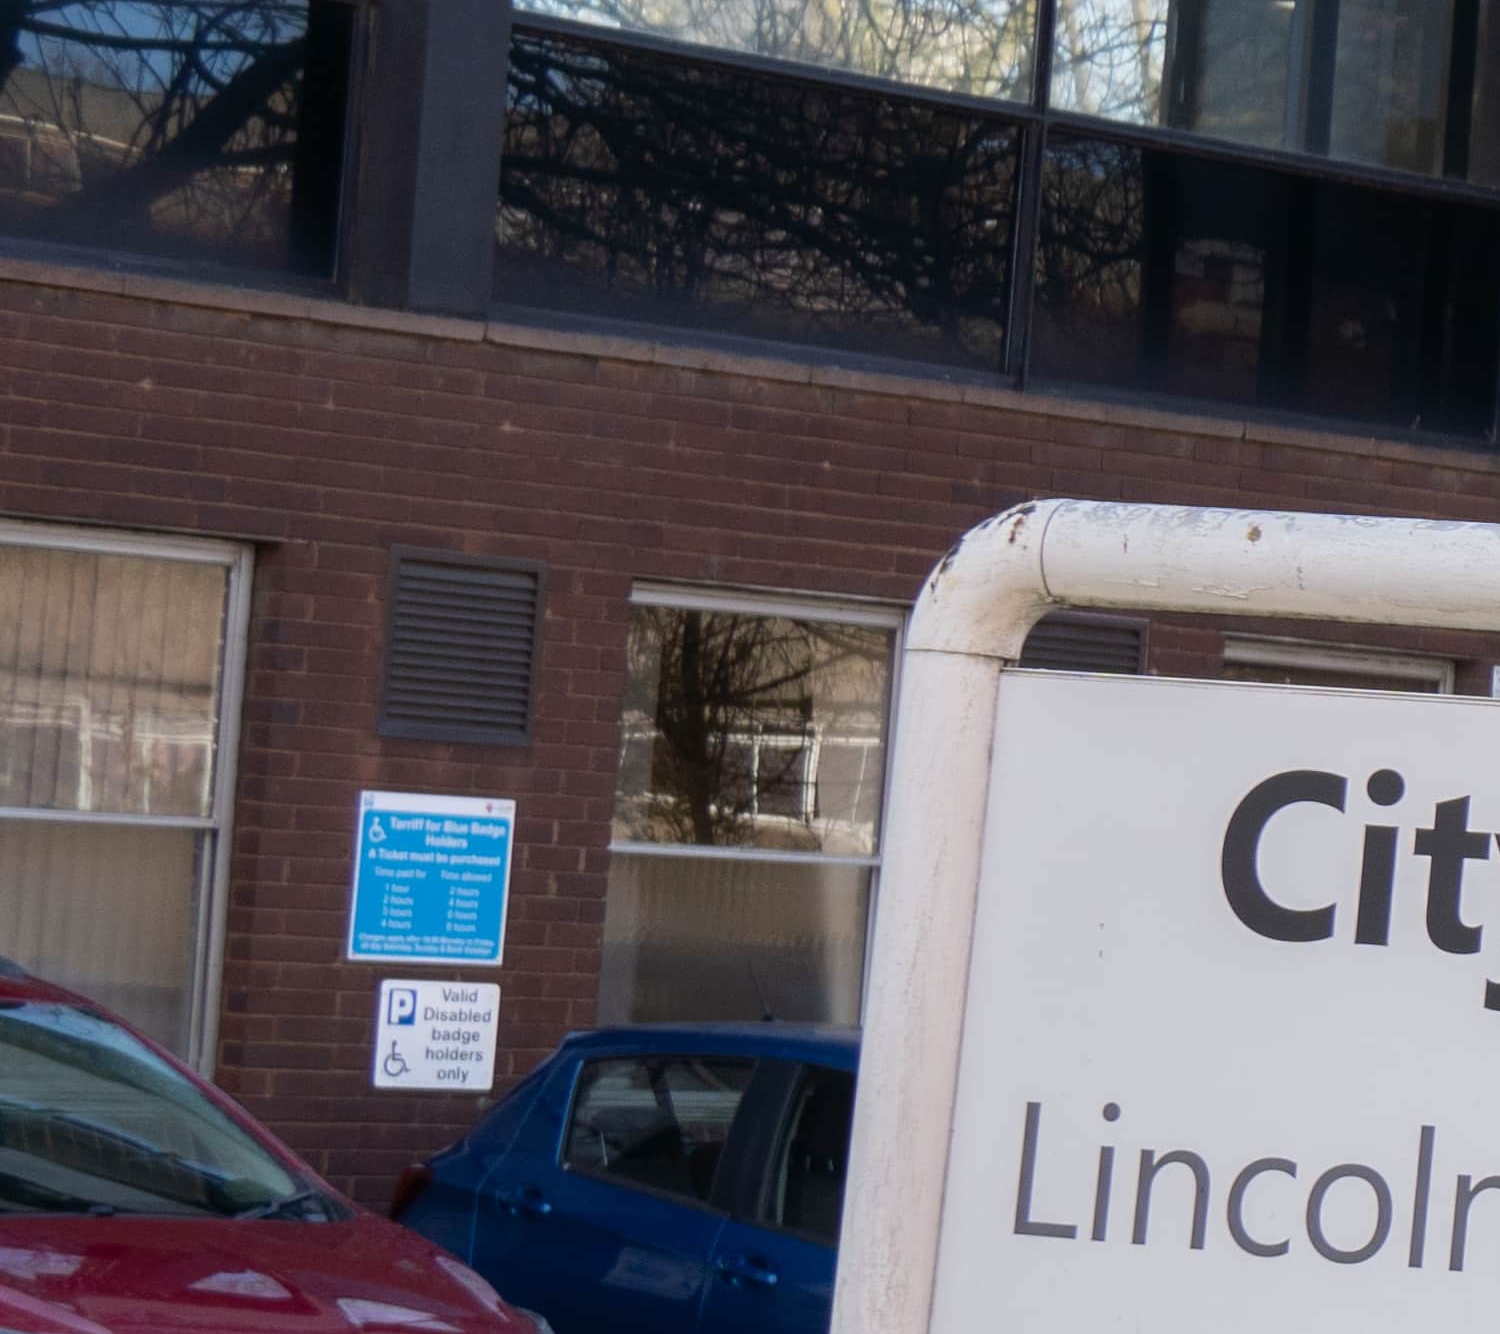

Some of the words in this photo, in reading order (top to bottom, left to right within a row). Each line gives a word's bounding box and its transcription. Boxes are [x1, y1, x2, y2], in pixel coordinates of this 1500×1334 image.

[443, 988, 478, 1004] Valid
[424, 1007, 492, 1023] Disabled
[431, 1027, 481, 1045] badge
[425, 1047, 484, 1062] holders
[436, 1067, 470, 1083] only
